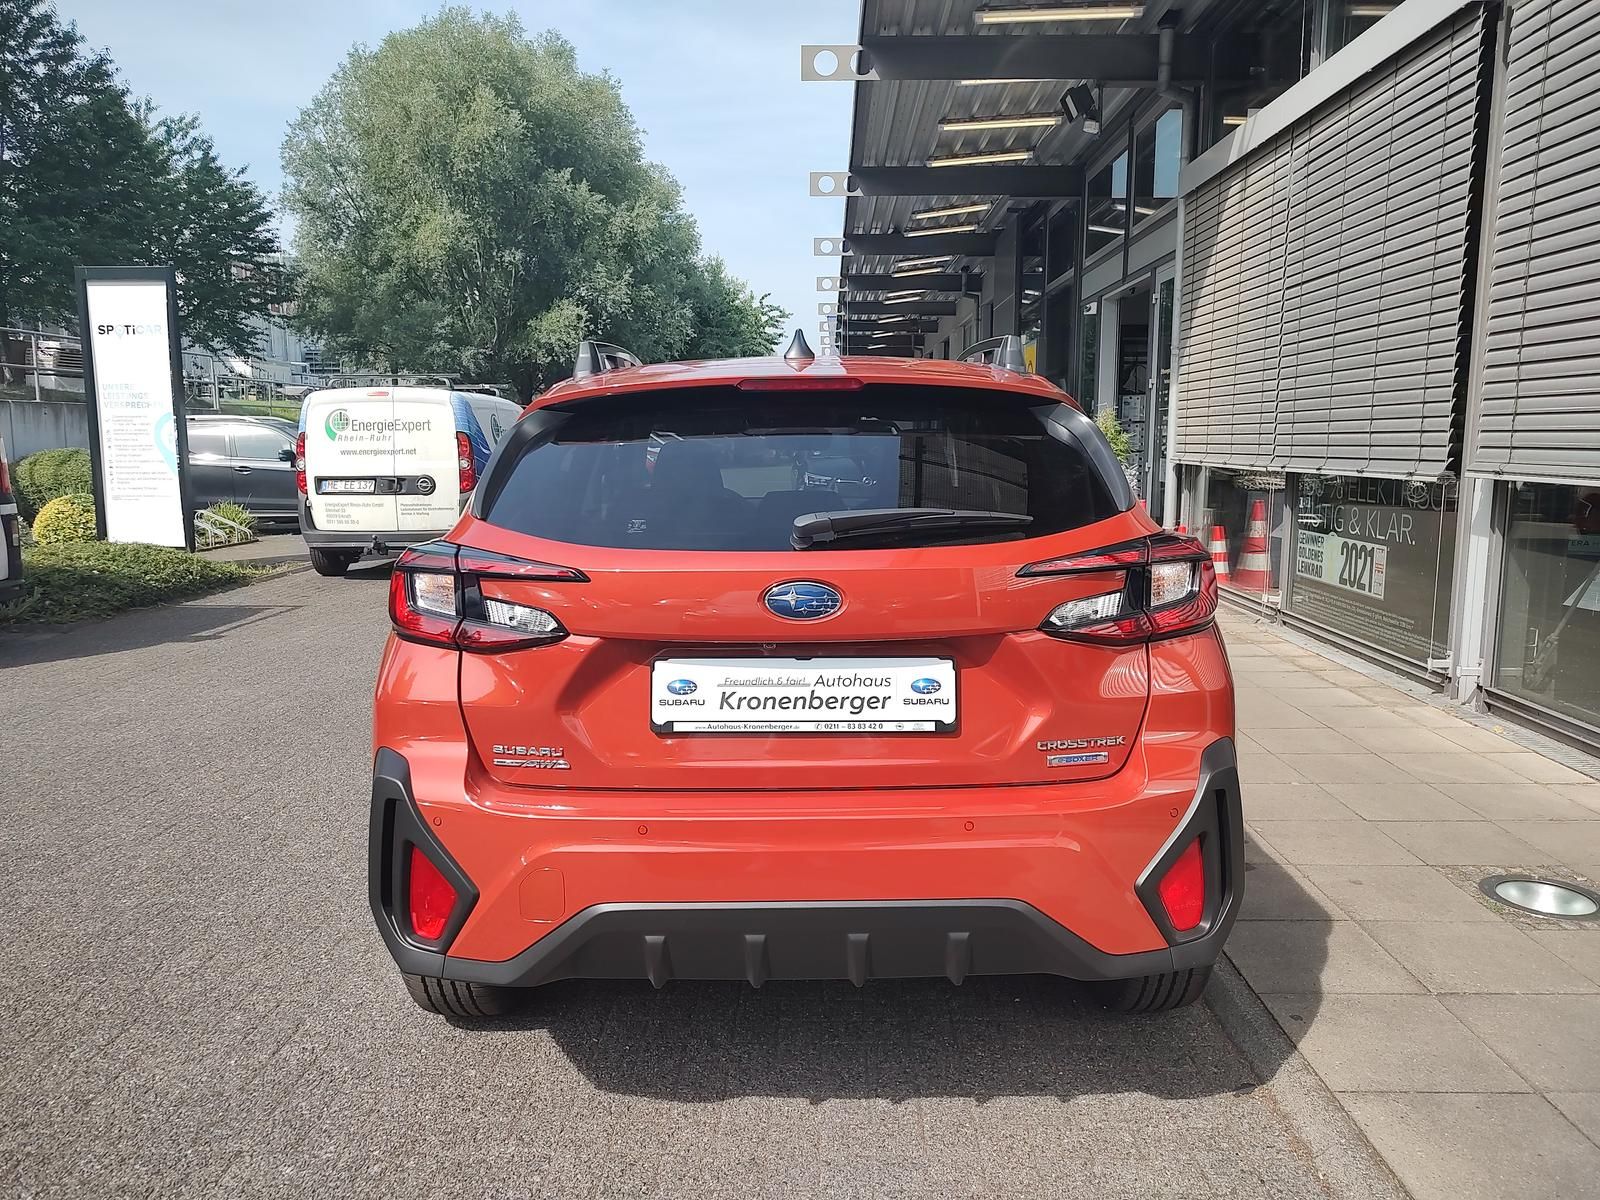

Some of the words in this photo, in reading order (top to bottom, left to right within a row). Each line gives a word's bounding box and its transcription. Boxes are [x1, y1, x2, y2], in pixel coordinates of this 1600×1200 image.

[351, 418, 432, 434] EnergieExpert
[337, 434, 392, 442] Rhein-Ruhr
[340, 447, 417, 457] www.energieexpert.net
[344, 480, 356, 490] EE
[357, 480, 374, 490] 137
[1348, 507, 1361, 536] &
[1366, 510, 1417, 546] KLAR.
[1299, 531, 1325, 549] GEWINNER
[1299, 546, 1324, 563] GOLDENES
[1298, 560, 1323, 578] LENKRAD
[1338, 541, 1375, 593] 2021
[724, 677, 774, 687] Freundlich
[776, 677, 784, 686] &
[813, 673, 892, 687] Autohaus
[719, 690, 892, 715] Kronenberger
[492, 744, 564, 757] SUBARU
[1036, 735, 1126, 750] CROSSTREK
